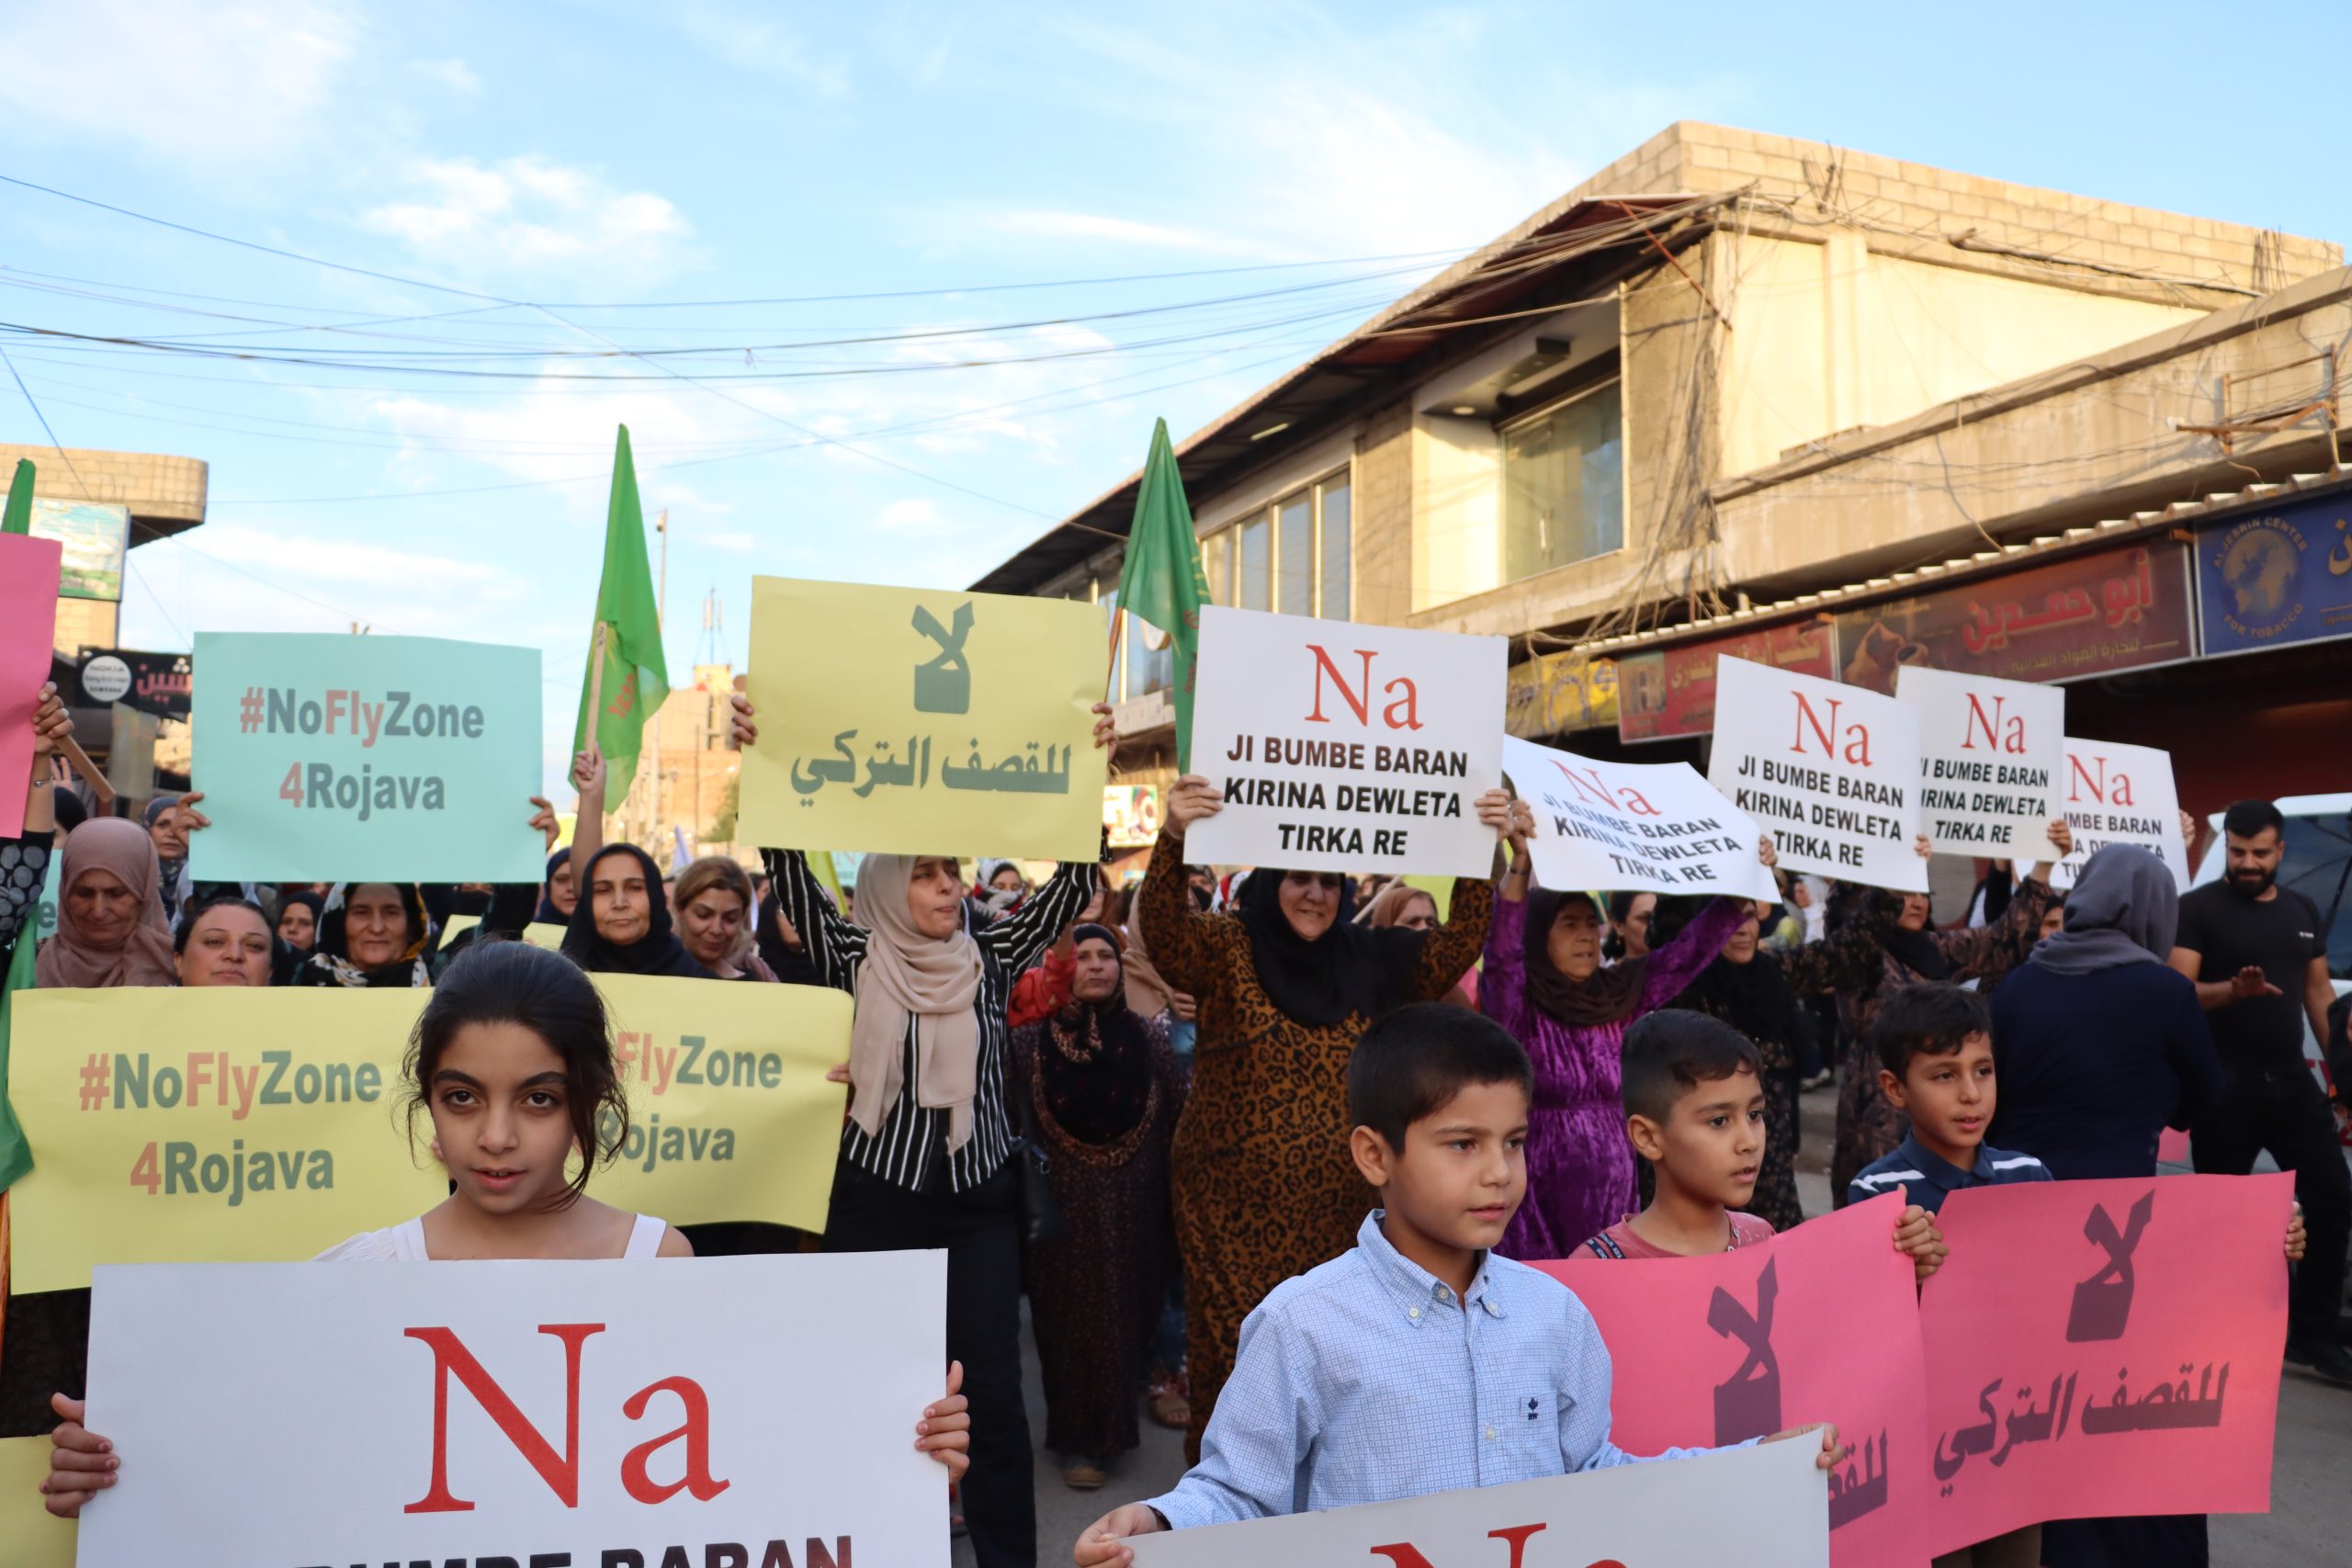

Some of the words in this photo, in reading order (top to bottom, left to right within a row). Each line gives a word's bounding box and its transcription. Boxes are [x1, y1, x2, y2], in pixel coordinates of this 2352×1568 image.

[2265, 516, 2308, 551] CENTER
[2223, 614, 2245, 637] FOR
[2250, 604, 2302, 637] TOBACCO
[911, 601, 974, 715] لا
[1305, 644, 1423, 730] Na
[240, 686, 484, 747] #NoFlyZone
[1790, 691, 1872, 767] Na
[1961, 693, 2027, 754] Na
[790, 729, 931, 807] التركي
[942, 737, 1070, 794] للقصف
[1227, 735, 1252, 761] JI
[1264, 737, 1364, 770] BUMBE
[1375, 746, 1467, 777] BARAN
[1738, 755, 1756, 777] JI
[1763, 761, 1830, 794] BUMBE
[1838, 776, 1904, 808] BARAN
[1933, 759, 1993, 783] BUMBE
[1997, 765, 2049, 787] BARAN
[2066, 753, 2135, 806] Na
[278, 762, 445, 820] 4Rojava
[1224, 777, 1326, 809] KIRINA
[1337, 785, 1461, 818] DEWLETA
[1544, 793, 1562, 808] JI
[1562, 801, 1637, 836] BUMBE
[1637, 818, 1722, 839] BARAN
[1548, 759, 1661, 816] Na
[1736, 787, 1804, 822] KIRINA
[1812, 805, 1902, 840] DEWLETA
[1921, 788, 1966, 810] IRINA
[1972, 793, 2045, 817] DEWLETA
[1279, 824, 1363, 854] TIRKA
[1374, 829, 1408, 855] RE
[1554, 815, 1631, 852] KIRINA
[1630, 837, 1743, 861] DEWLETA
[1774, 830, 1832, 861] TIRKA
[1839, 844, 1863, 866] RE
[1935, 820, 1984, 841] TIRKA
[1990, 825, 2012, 843] RE
[2064, 812, 2102, 830] MBE
[2109, 816, 2162, 835] BARAN
[1610, 853, 1679, 884] TIRKA
[1679, 864, 1717, 882] RE
[79, 1049, 381, 1121] #NoFlyZone
[616, 1032, 782, 1096] FlyZone
[594, 1112, 735, 1173] Rojava
[130, 1139, 334, 1206] 4Rojava
[2066, 1189, 2155, 1342] لا
[1707, 1254, 1782, 1449] لا
[403, 1323, 730, 1514] Na
[2081, 1359, 2231, 1434] للقصف
[1933, 1371, 2078, 1497] التركي
[1828, 1427, 1887, 1531] للق
